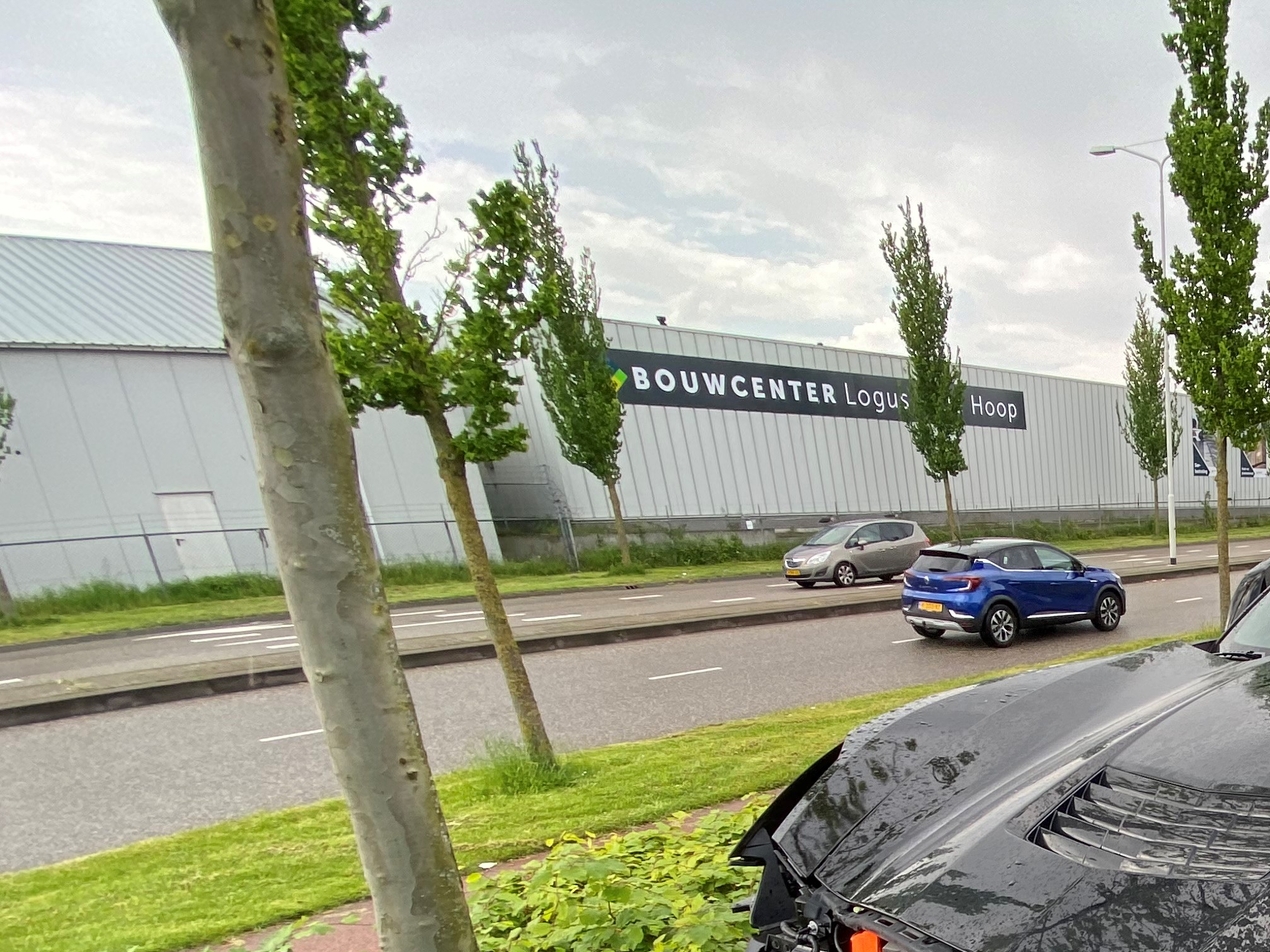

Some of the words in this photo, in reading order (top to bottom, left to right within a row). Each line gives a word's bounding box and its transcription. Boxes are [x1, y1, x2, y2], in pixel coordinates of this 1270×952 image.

[631, 366, 837, 404] BOUWCENTER
[843, 382, 910, 413] Logus
[970, 394, 1017, 423] Hoop
